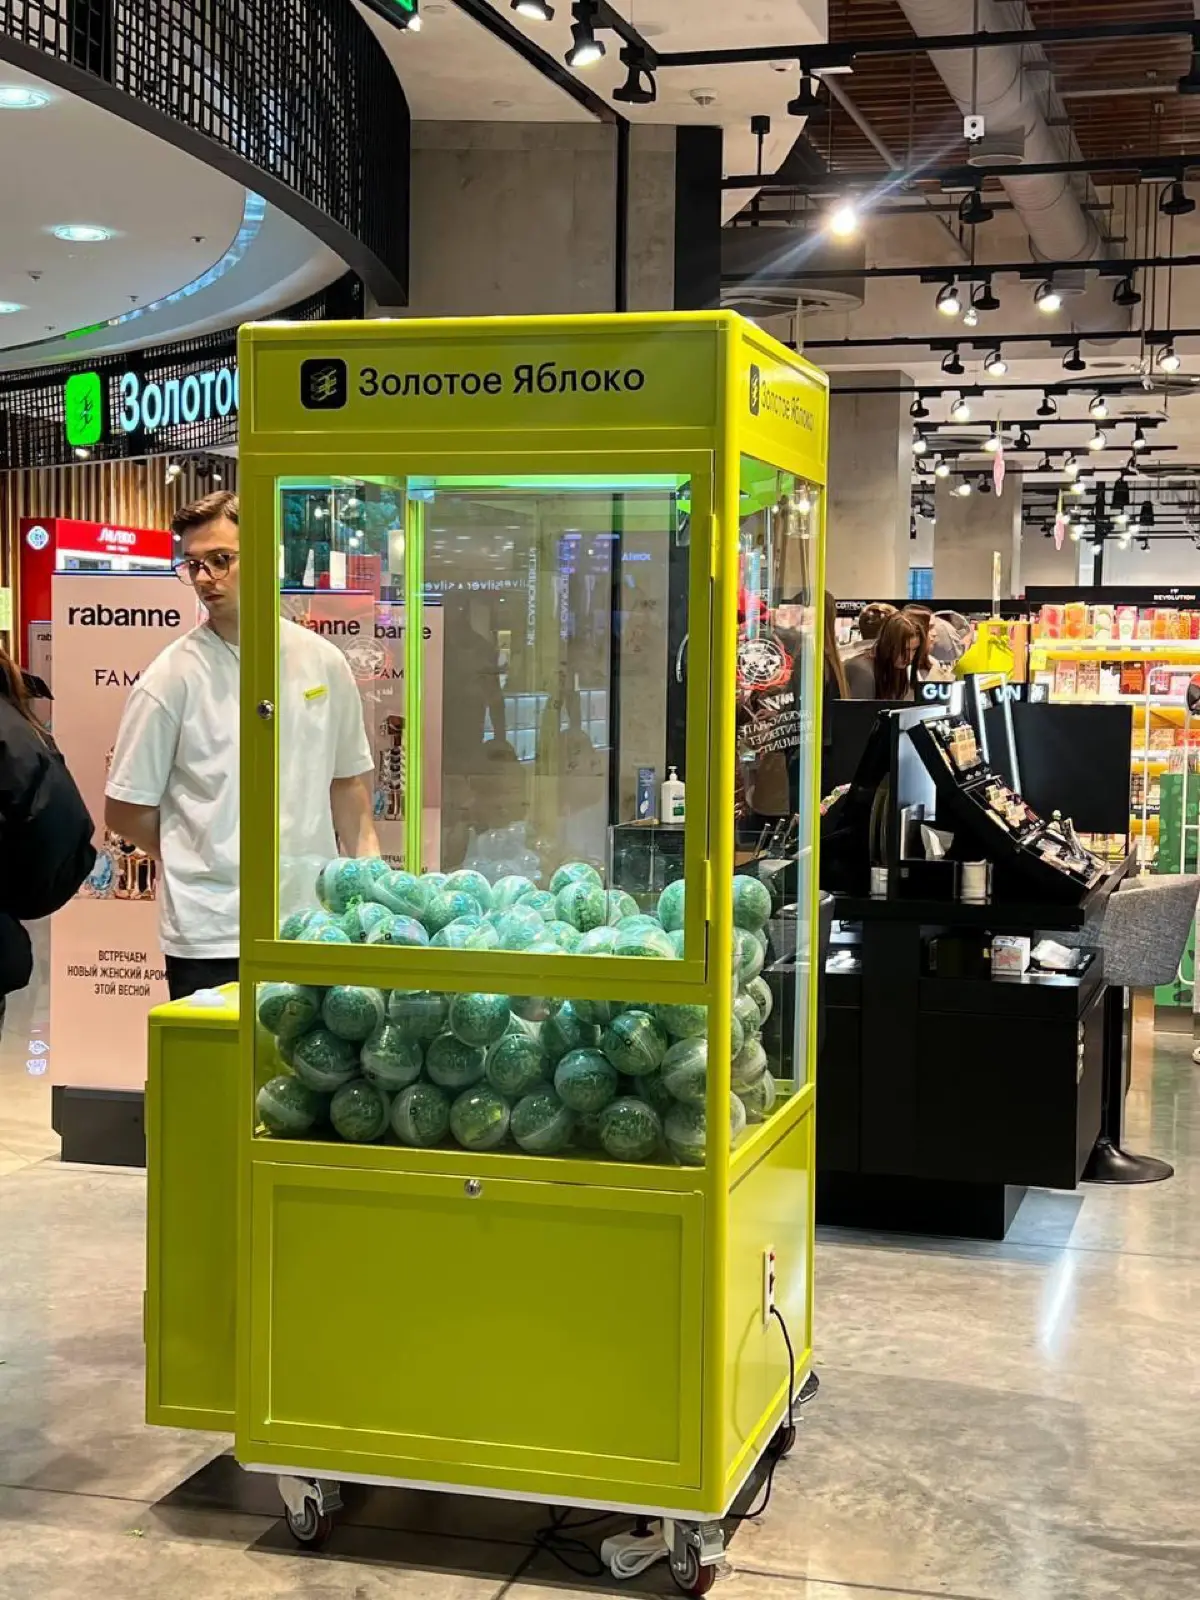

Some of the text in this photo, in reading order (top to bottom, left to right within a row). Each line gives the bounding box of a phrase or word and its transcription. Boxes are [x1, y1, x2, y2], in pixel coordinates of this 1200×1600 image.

[358, 362, 646, 397] Золотое Яблоко
[68, 604, 181, 627] rabanne
[94, 669, 146, 687] FAM
[98, 950, 147, 963] ВСТРЕЧАЕМ
[67, 964, 98, 977] НОВЫЙ
[100, 966, 141, 980] ЖЕНСКИЙ
[94, 981, 151, 997] ЭТОЙ ВЕСНОЙ
